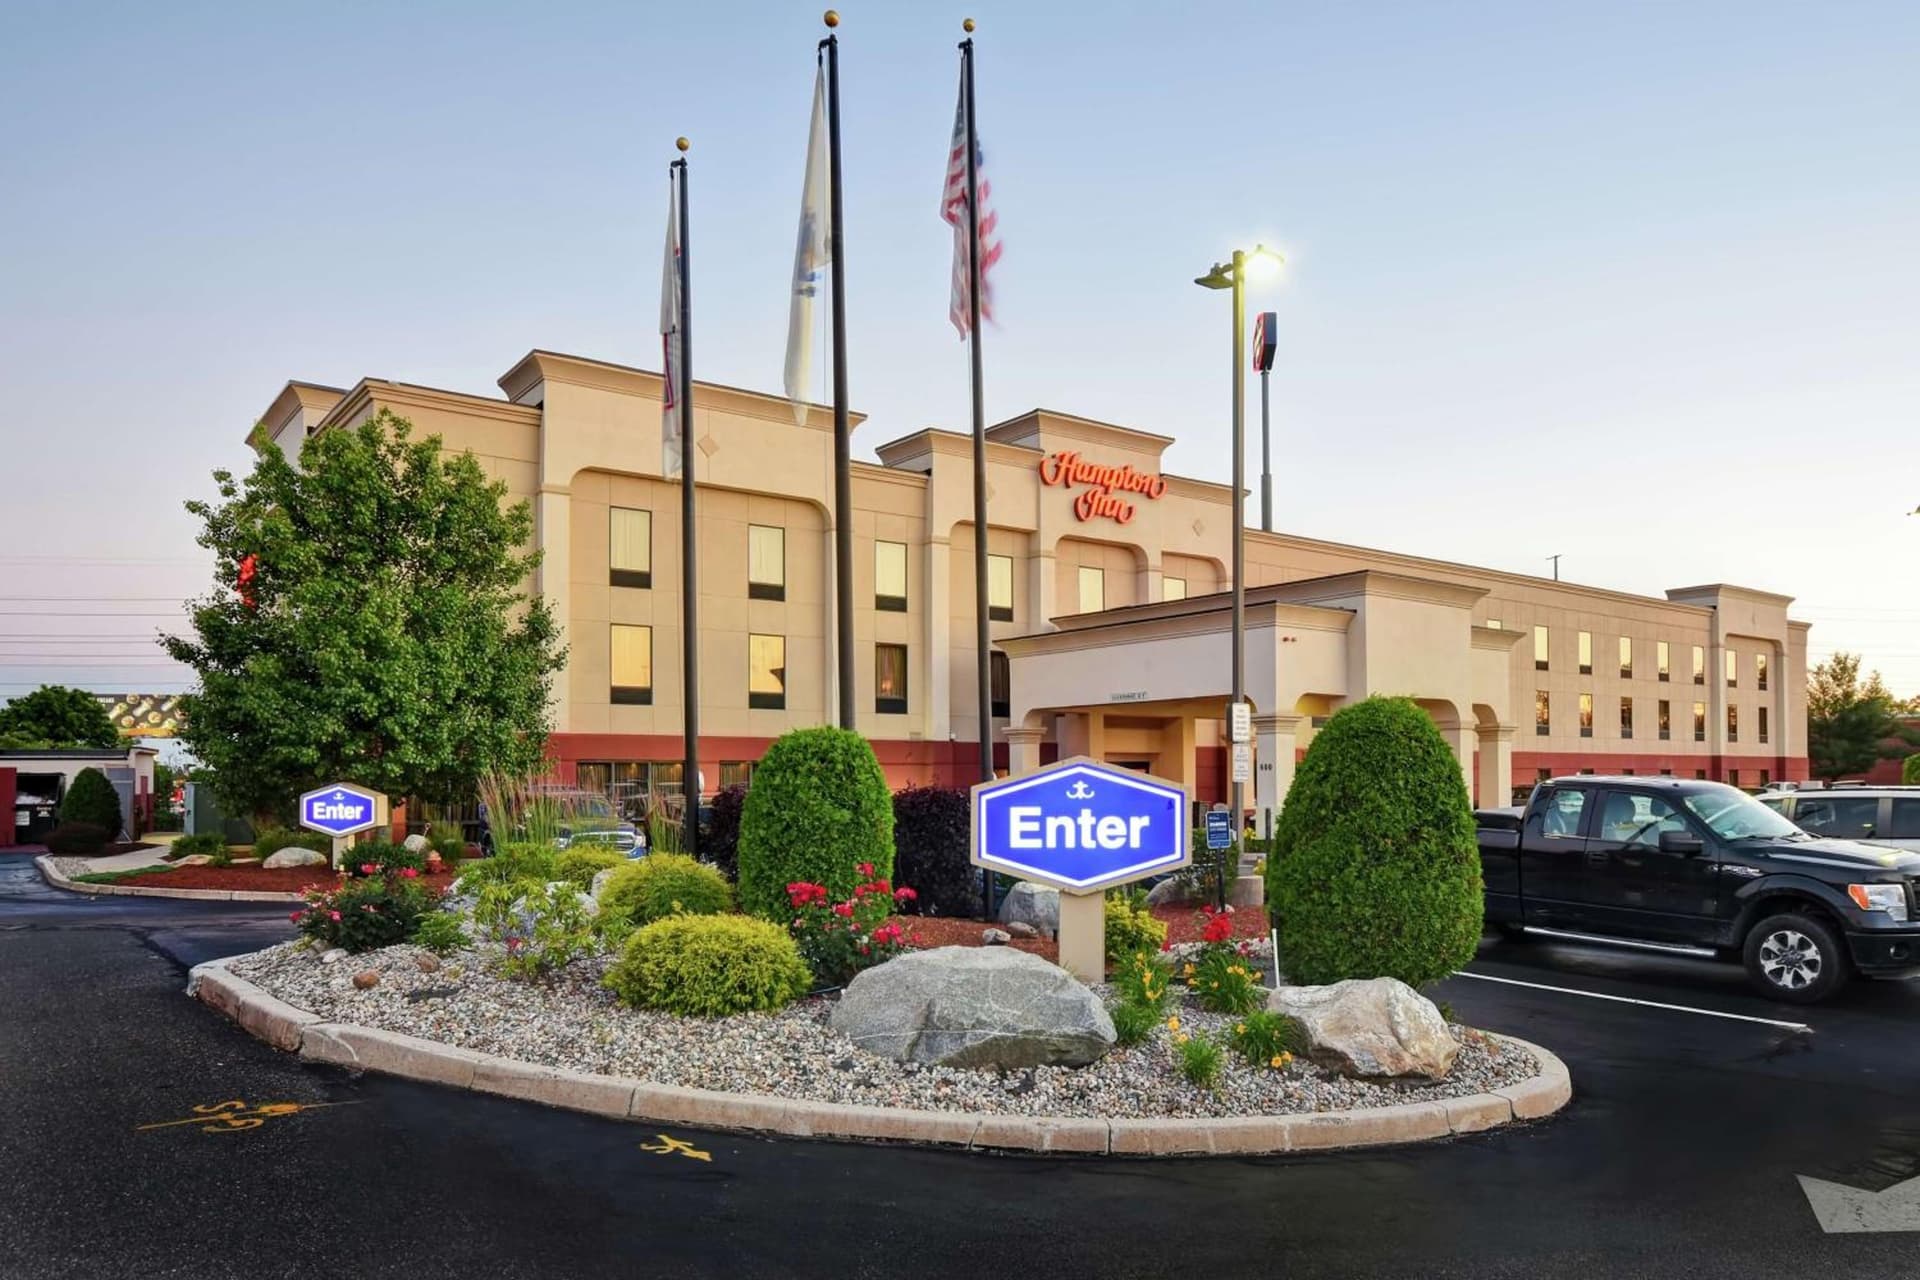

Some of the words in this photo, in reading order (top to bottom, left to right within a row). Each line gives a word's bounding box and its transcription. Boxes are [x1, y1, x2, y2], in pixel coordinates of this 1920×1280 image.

[1039, 451, 1168, 499] Hampton
[1074, 487, 1137, 524] Inn
[312, 801, 364, 820] Enter
[1009, 805, 1151, 850] Enter
